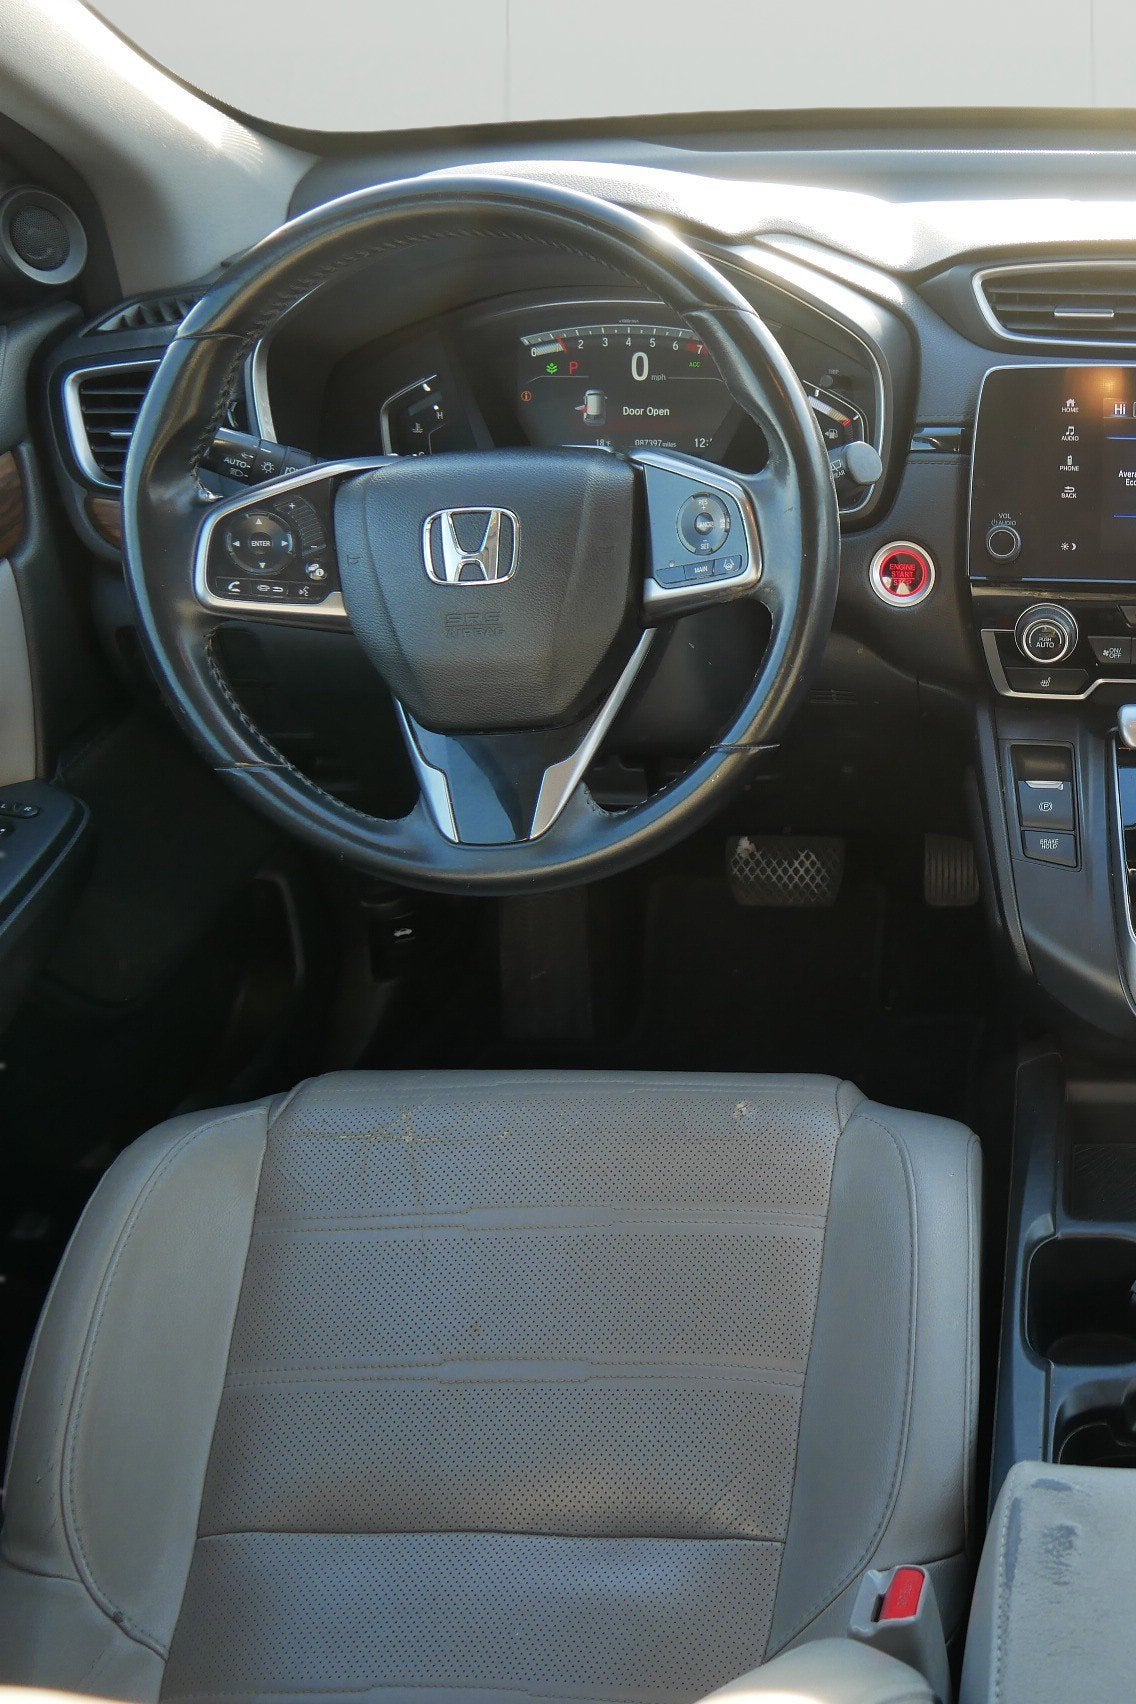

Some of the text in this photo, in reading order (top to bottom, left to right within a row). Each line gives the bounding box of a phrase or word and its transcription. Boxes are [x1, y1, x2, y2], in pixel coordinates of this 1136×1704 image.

[577, 339, 584, 350] 2
[602, 337, 609, 347] 3
[625, 337, 632, 347] 4
[649, 337, 656, 348] 5
[672, 341, 679, 351] 6
[696, 344, 703, 355] 7
[569, 361, 579, 375] P
[631, 351, 649, 381] 0
[622, 406, 670, 417] Door Open
[1114, 403, 1126, 415] Hi
[223, 456, 248, 469] AUTO
[890, 563, 916, 571] ENGINE
